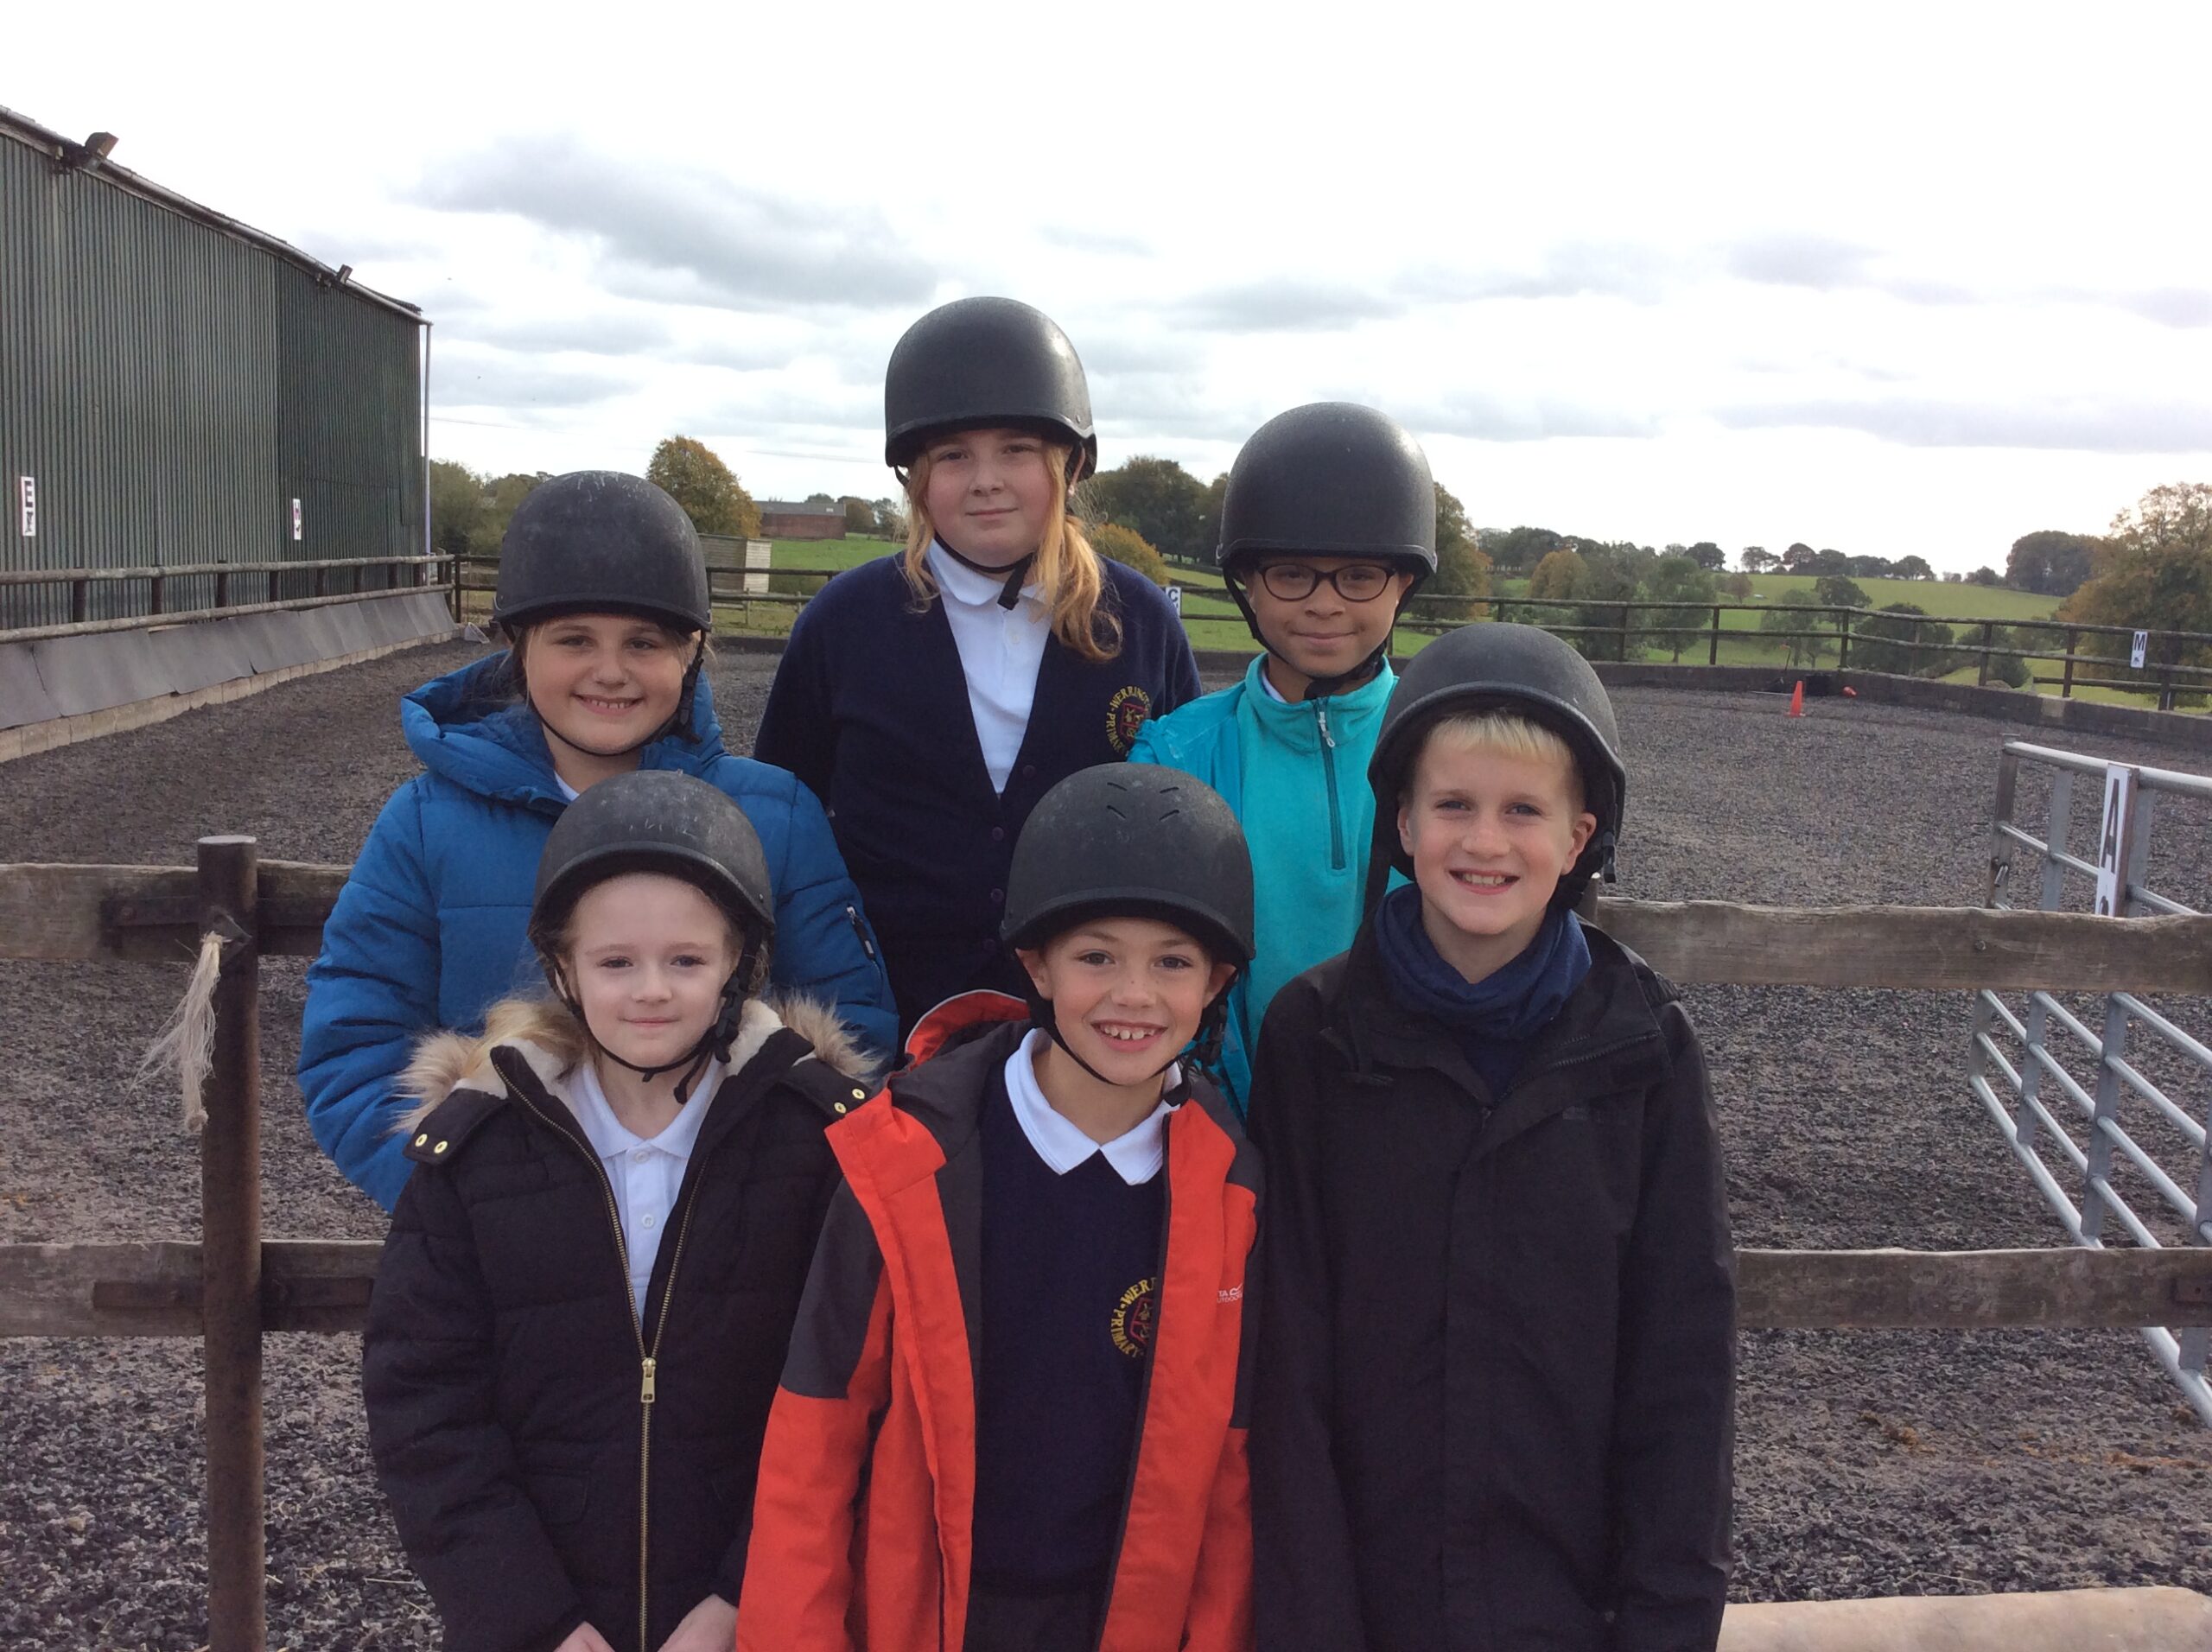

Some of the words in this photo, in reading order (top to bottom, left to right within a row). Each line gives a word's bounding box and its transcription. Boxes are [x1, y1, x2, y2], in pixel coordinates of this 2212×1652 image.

[24, 480, 33, 508] E
[1168, 588, 1179, 602] C
[2134, 633, 2146, 651] M
[1109, 685, 1150, 715] WERRINGT
[1106, 712, 1125, 754] PRIMAR
[2101, 778, 2120, 875] A
